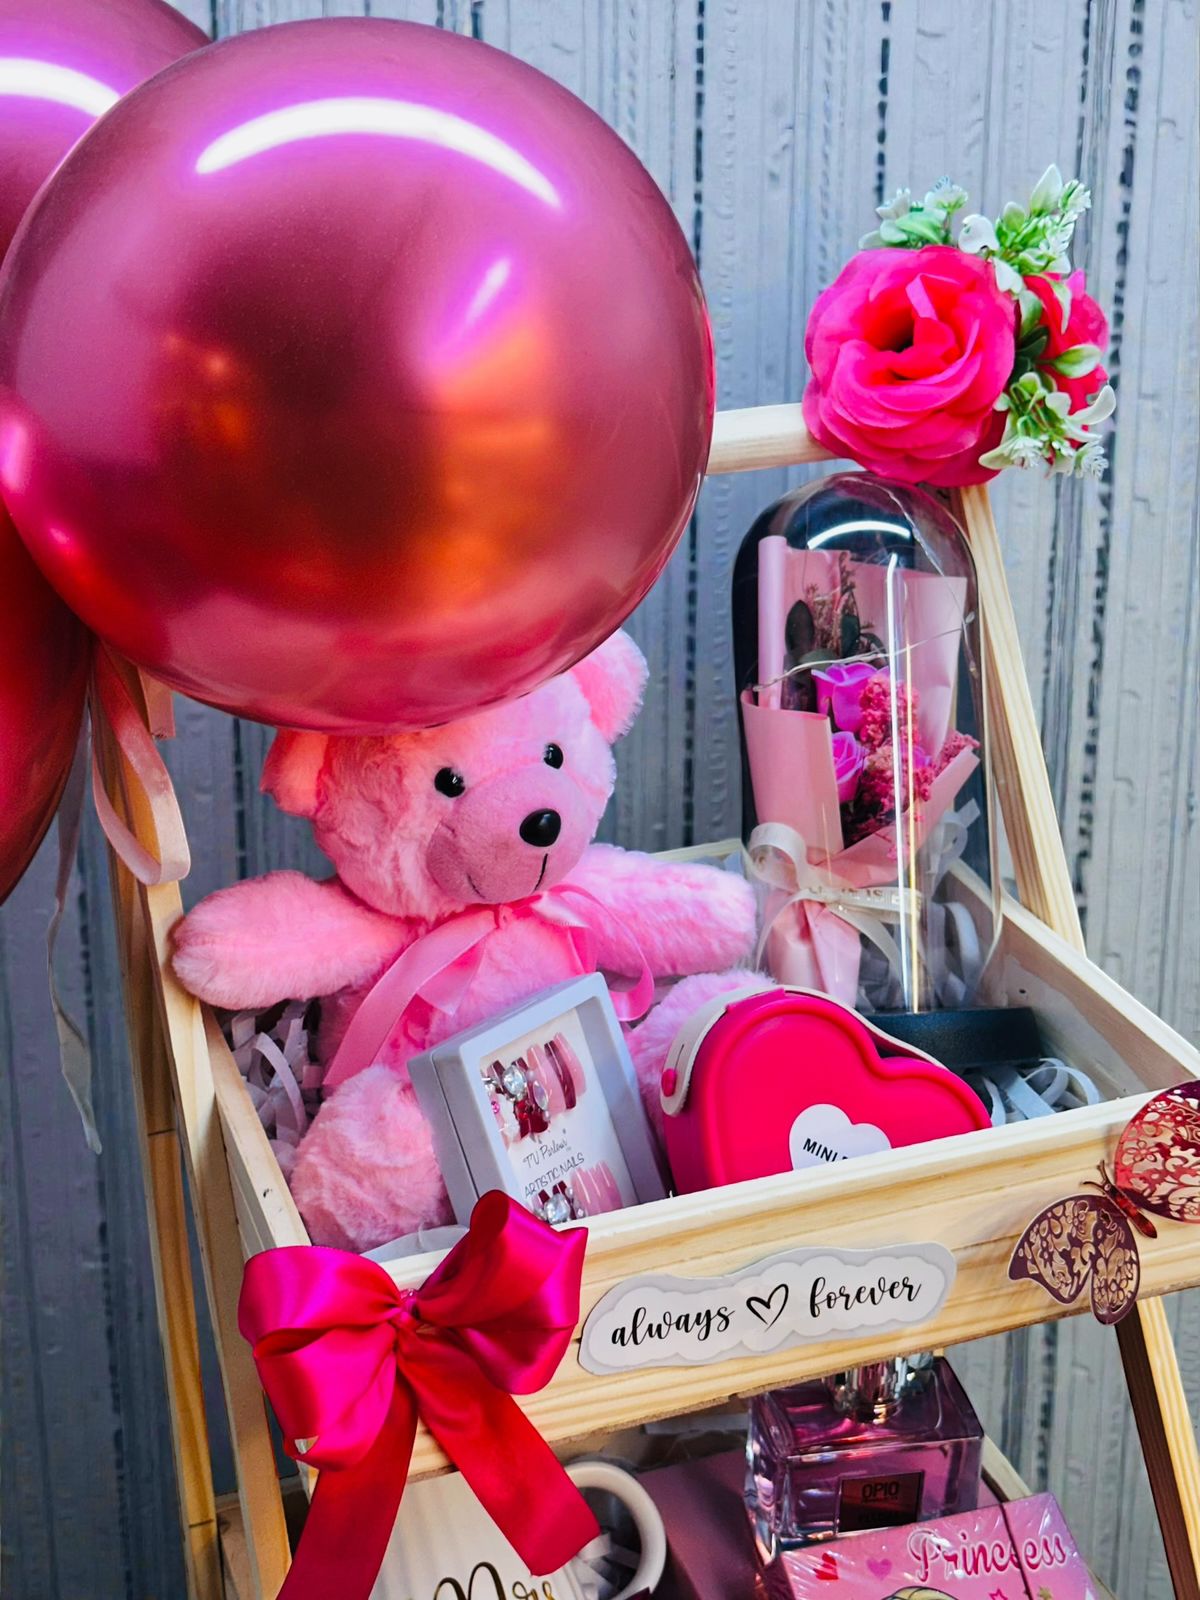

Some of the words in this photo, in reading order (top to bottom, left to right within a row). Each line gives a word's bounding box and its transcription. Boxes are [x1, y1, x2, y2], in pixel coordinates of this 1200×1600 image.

[803, 1138, 838, 1162] MINI
[611, 1304, 737, 1347] always
[808, 1275, 923, 1319] forever
[862, 1481, 900, 1498] OPIO
[907, 1529, 1067, 1583] Princess
